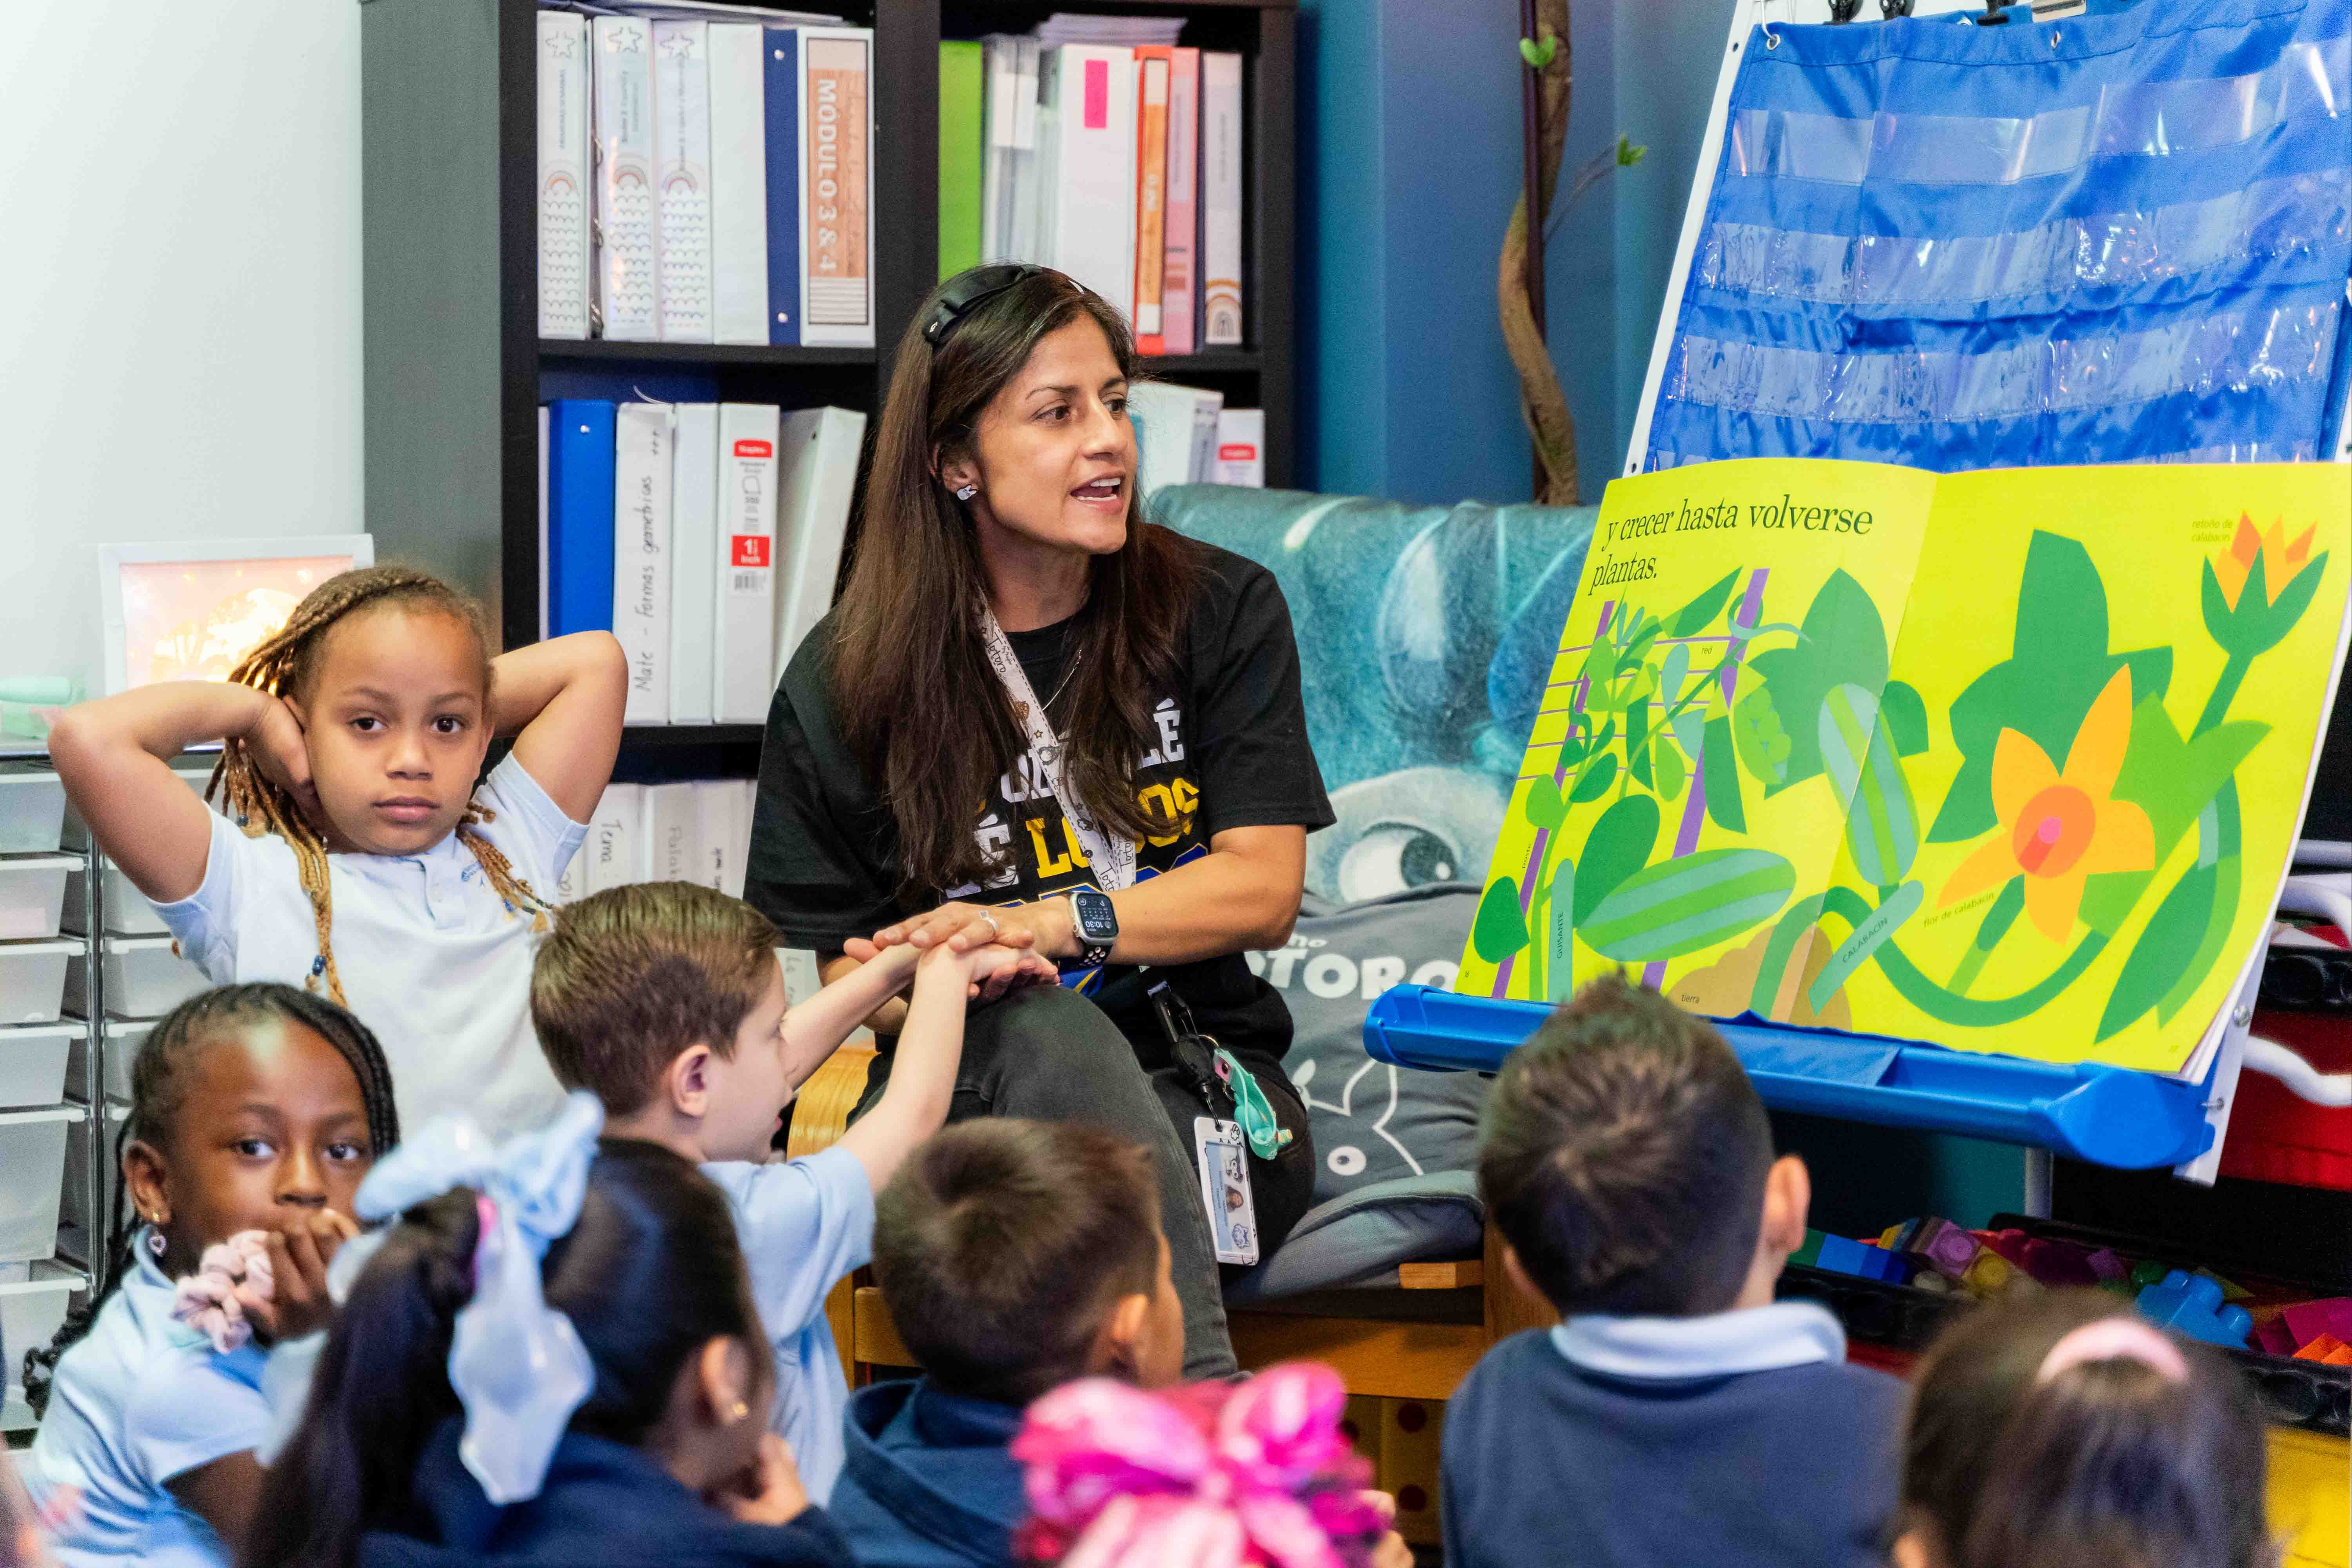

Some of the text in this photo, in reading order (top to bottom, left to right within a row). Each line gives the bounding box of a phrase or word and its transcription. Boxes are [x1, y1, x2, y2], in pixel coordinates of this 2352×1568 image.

[818, 205, 836, 222] 3
[817, 227, 836, 247] &
[819, 254, 837, 271] 4
[1601, 494, 1873, 551] y crecer hasta volverse
[1588, 553, 1658, 596] plantas.
[634, 564, 655, 619] Formas
[1701, 645, 1713, 655] red
[634, 650, 655, 693] Mate
[600, 819, 624, 864] Tema
[1521, 842, 1532, 869] poste
[1923, 916, 1939, 928] flor
[1941, 910, 1952, 920] de
[1556, 910, 1564, 960] GUISANTE
[1464, 970, 1470, 979] 16
[1681, 992, 1701, 1005] tierra
